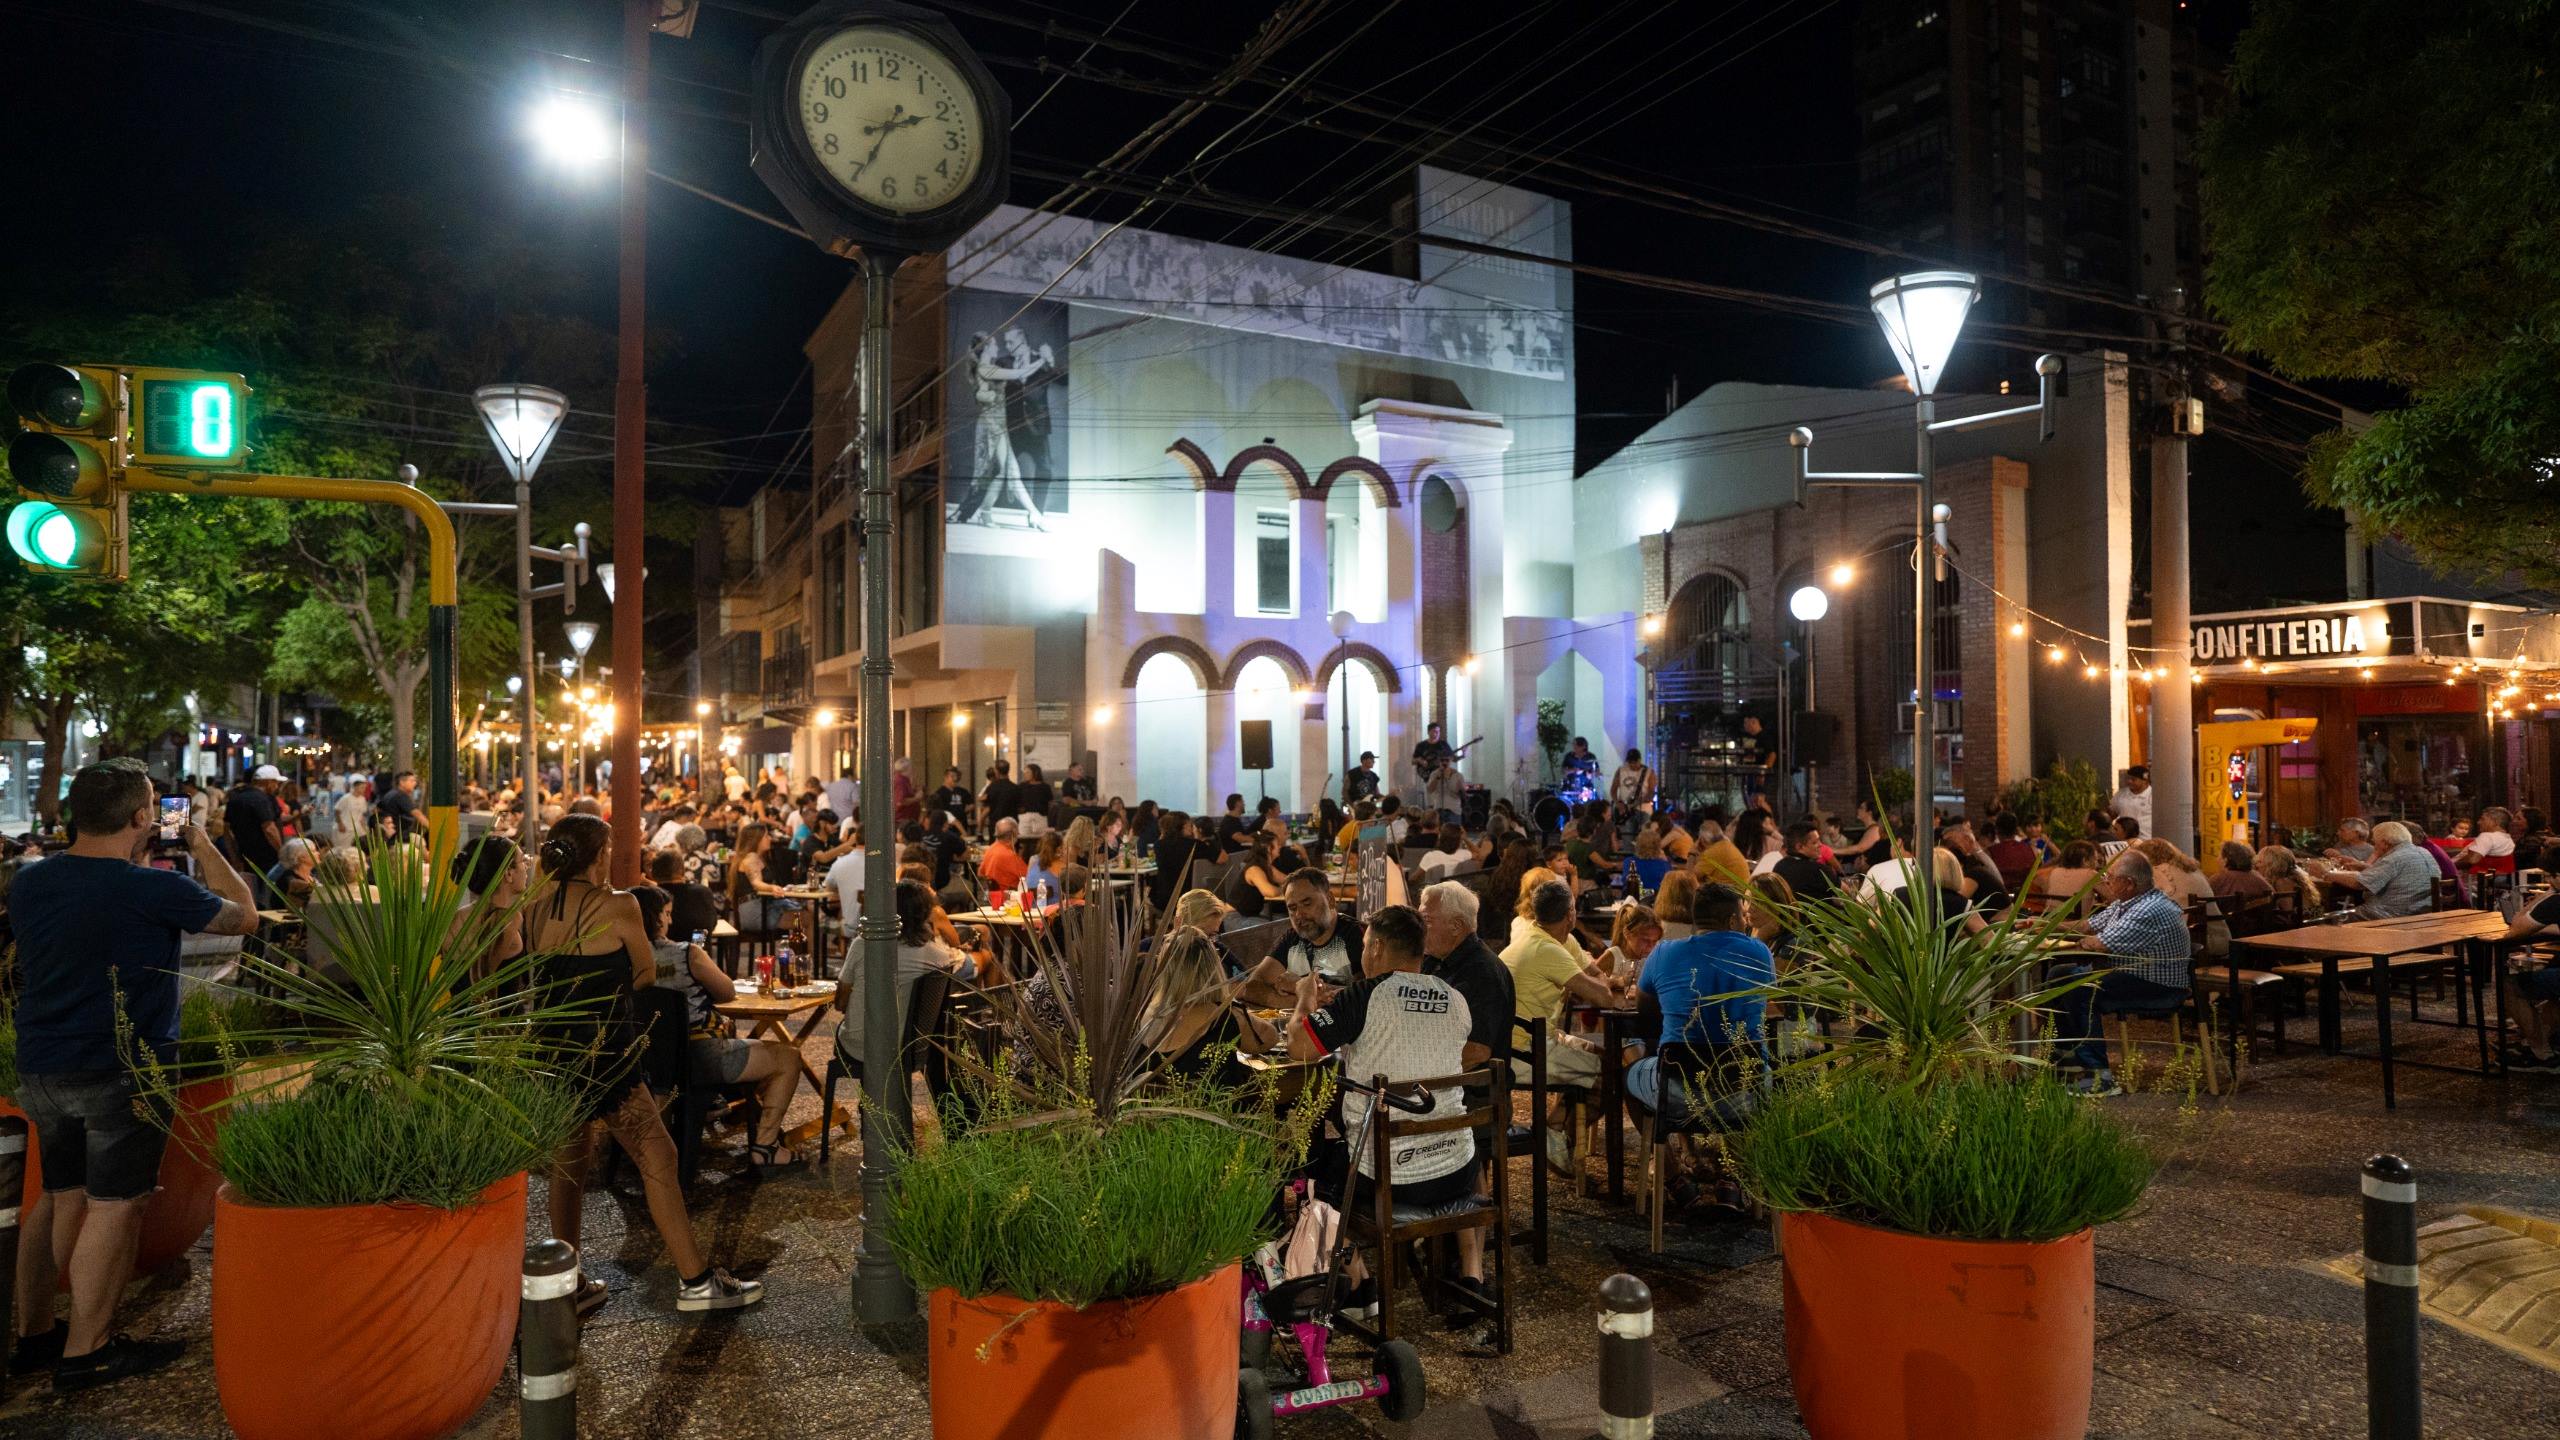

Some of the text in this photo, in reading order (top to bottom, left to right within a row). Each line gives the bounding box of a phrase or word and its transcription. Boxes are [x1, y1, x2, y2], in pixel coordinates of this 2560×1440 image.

[851, 60, 868, 84] 11
[878, 56, 901, 81] 12
[824, 75, 847, 99] 10
[917, 74, 925, 95] 1
[813, 102, 828, 124] 9
[935, 100, 950, 122] 2
[824, 133, 839, 155] 8
[943, 131, 959, 151] 3
[849, 161, 865, 182] 7
[935, 158, 948, 179] 4
[881, 177, 896, 199] 6
[915, 176, 928, 198] 5
[191, 385, 231, 456] 0
[2202, 746, 2222, 857] BOXER
[1397, 986, 1449, 1001] flecha
[1405, 1001, 1448, 1013] BUS
[1415, 1138, 1457, 1155] CREDIFIN
[1293, 1382, 1361, 1405] JUANITA
